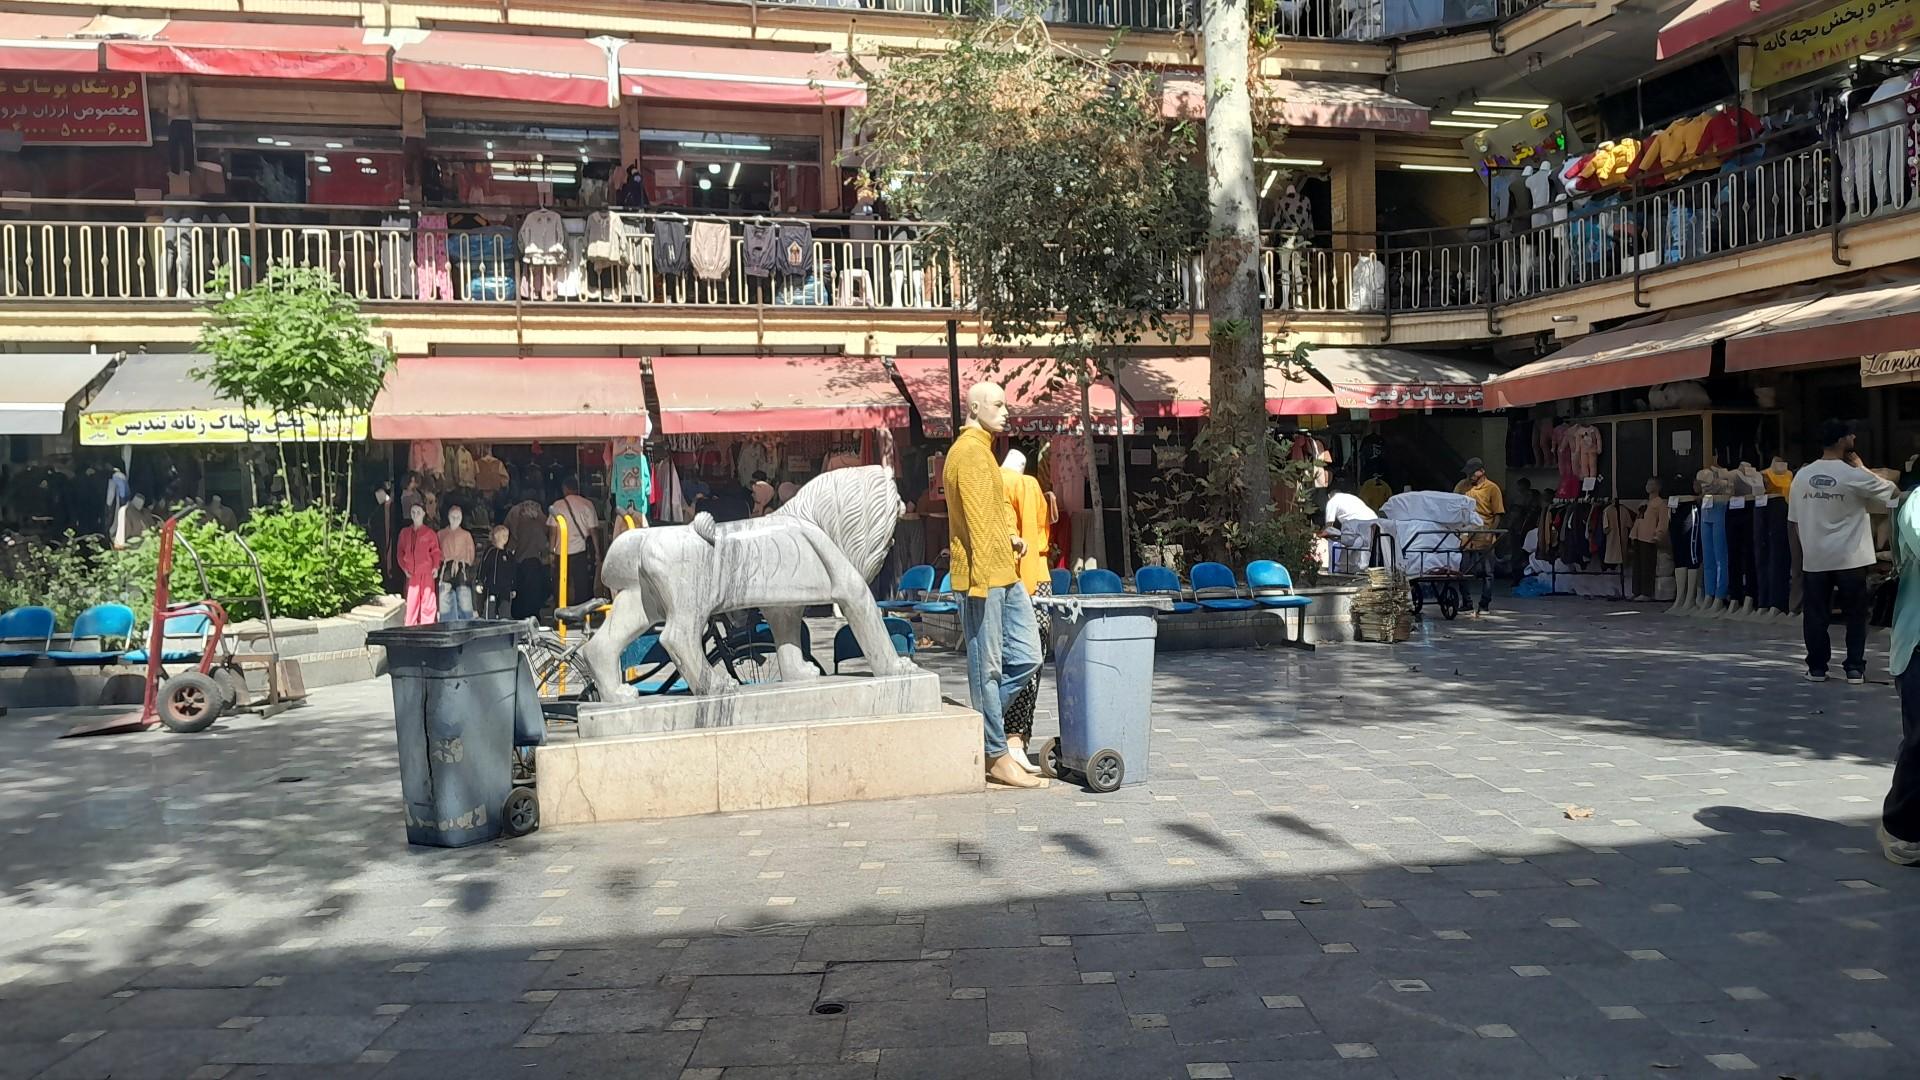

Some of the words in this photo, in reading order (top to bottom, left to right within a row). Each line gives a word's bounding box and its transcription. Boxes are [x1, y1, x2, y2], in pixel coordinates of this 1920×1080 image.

[1867, 3, 1876, 18] و
[1821, 6, 1865, 36] پخش
[1789, 25, 1819, 45] بچه
[13, 79, 67, 98] پوشاک
[72, 79, 137, 98] فروشگاه
[1, 104, 27, 118] فرو
[33, 104, 69, 118] ارزان
[73, 104, 139, 120] مخصوص
[1413, 385, 1455, 404] پوشاک
[1457, 386, 1484, 404] خش
[116, 415, 166, 436] تندیس
[171, 414, 205, 435] زنانه
[210, 414, 260, 435] پوشاک
